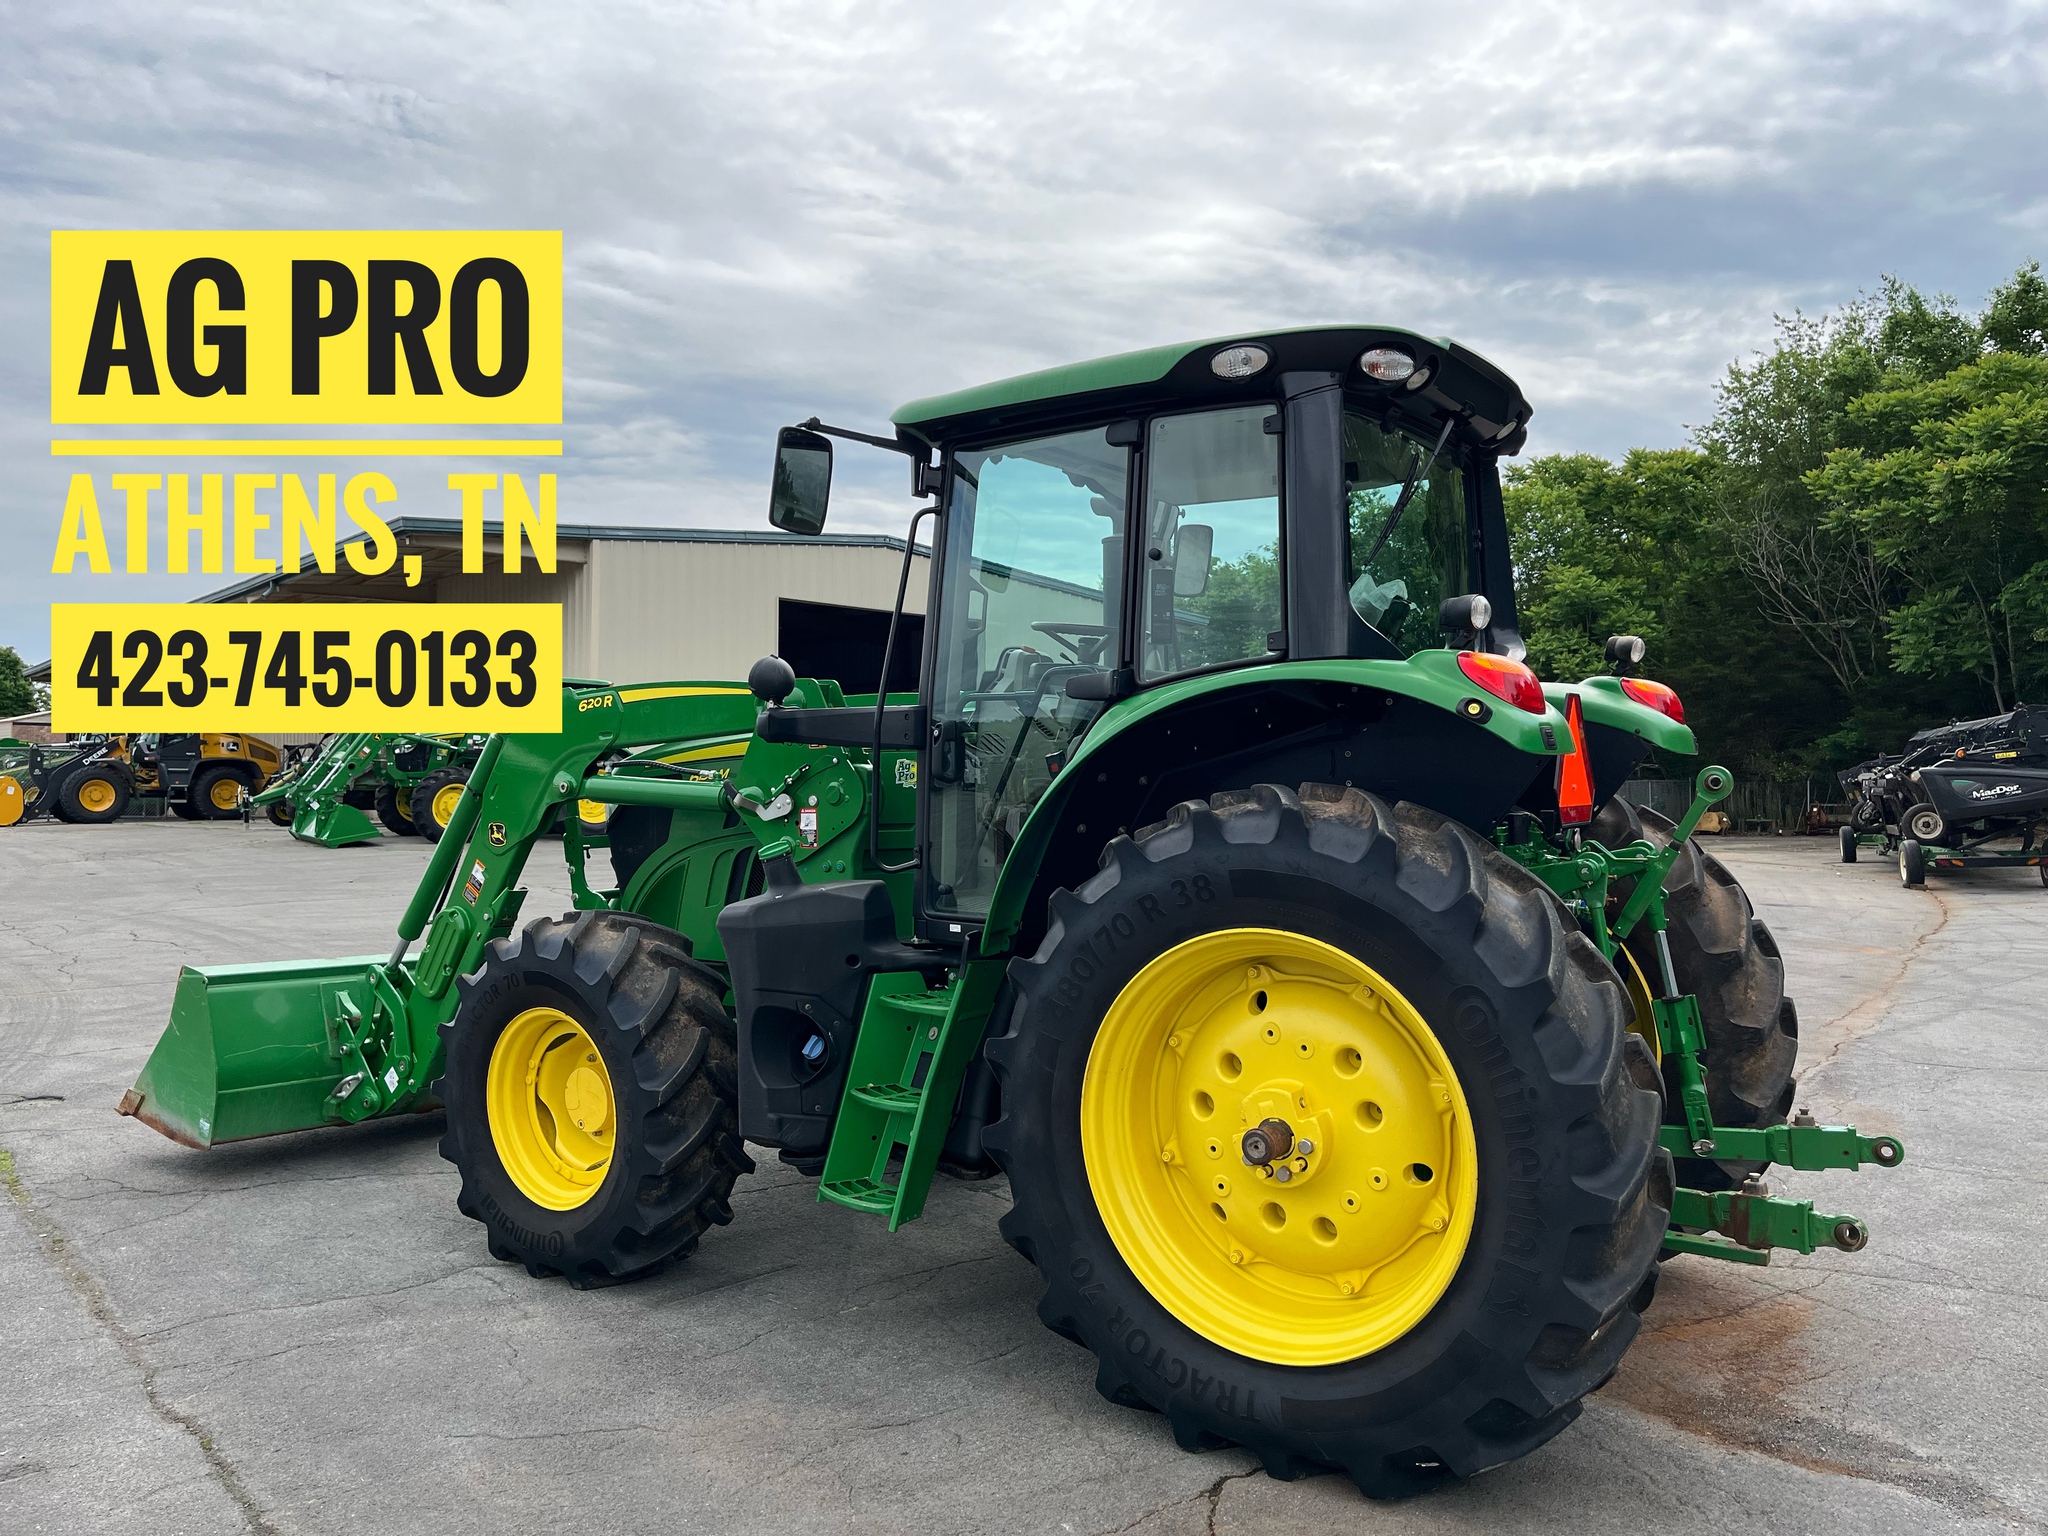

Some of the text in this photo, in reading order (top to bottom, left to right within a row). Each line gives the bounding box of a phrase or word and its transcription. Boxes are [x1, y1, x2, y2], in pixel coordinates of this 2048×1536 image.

[82, 746, 108, 766] DEERE
[1137, 893, 1168, 923] R
[1170, 874, 1217, 908] 38
[502, 972, 520, 991] 70
[1449, 984, 1549, 1286] Continental
[483, 1193, 565, 1257] Continental
[1068, 1257, 1261, 1422] TRACTOR 70
